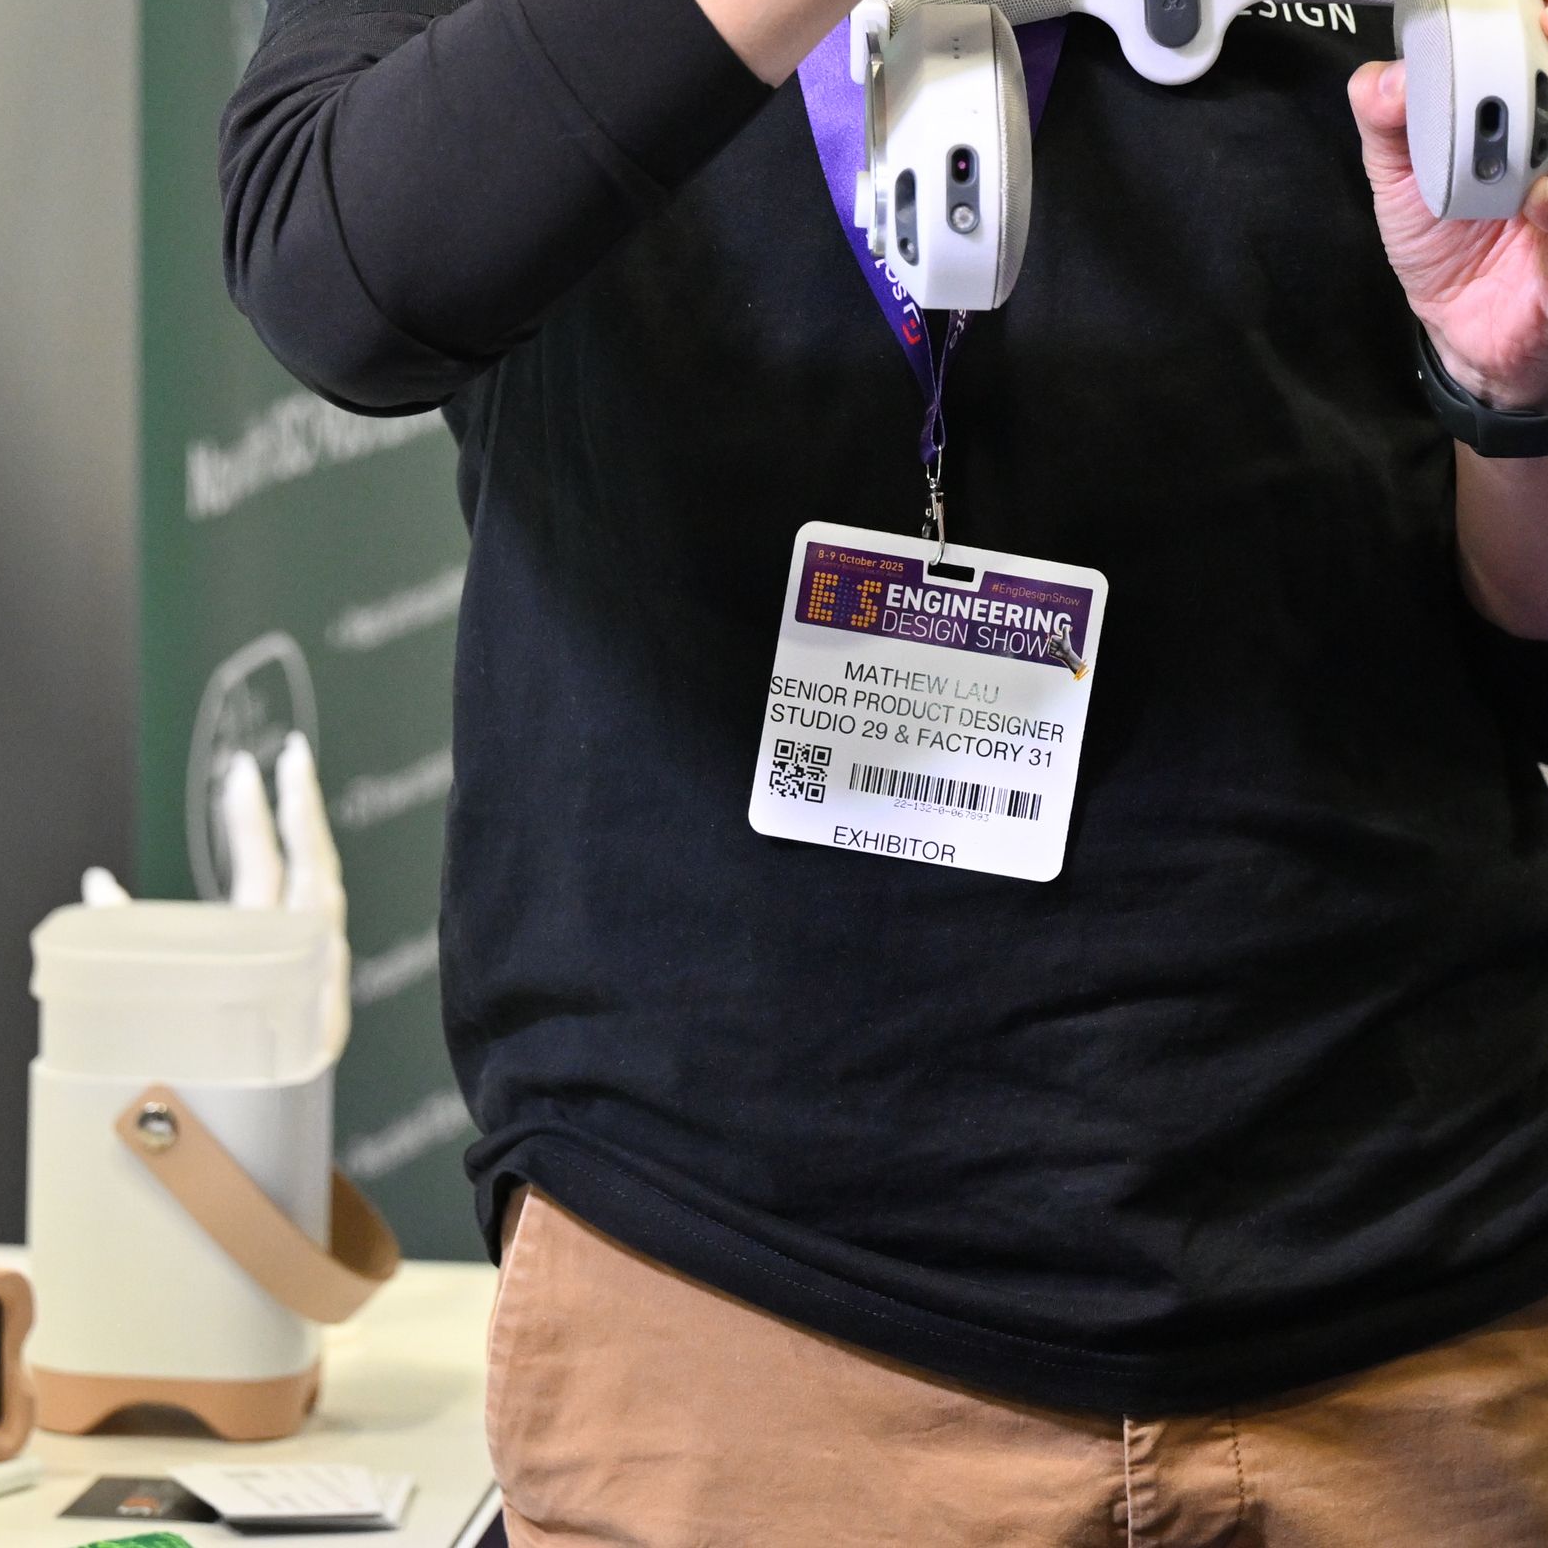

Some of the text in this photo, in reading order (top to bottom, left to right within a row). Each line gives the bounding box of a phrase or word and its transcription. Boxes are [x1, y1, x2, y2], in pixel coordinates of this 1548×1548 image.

[839, 553, 877, 568] October
[879, 559, 905, 572] 2025
[886, 583, 1073, 637] ENGINEERING
[990, 582, 1081, 607] #EngDesignShow
[881, 610, 1050, 658] DESIGN SHOW
[844, 661, 1000, 705] MATHEW LAU
[770, 675, 1065, 744] SENIOR PRODUCT DESIGNER
[770, 703, 1053, 768] STUDIO 29 & FACTORY 31
[832, 825, 957, 864] EXHIBITOR
